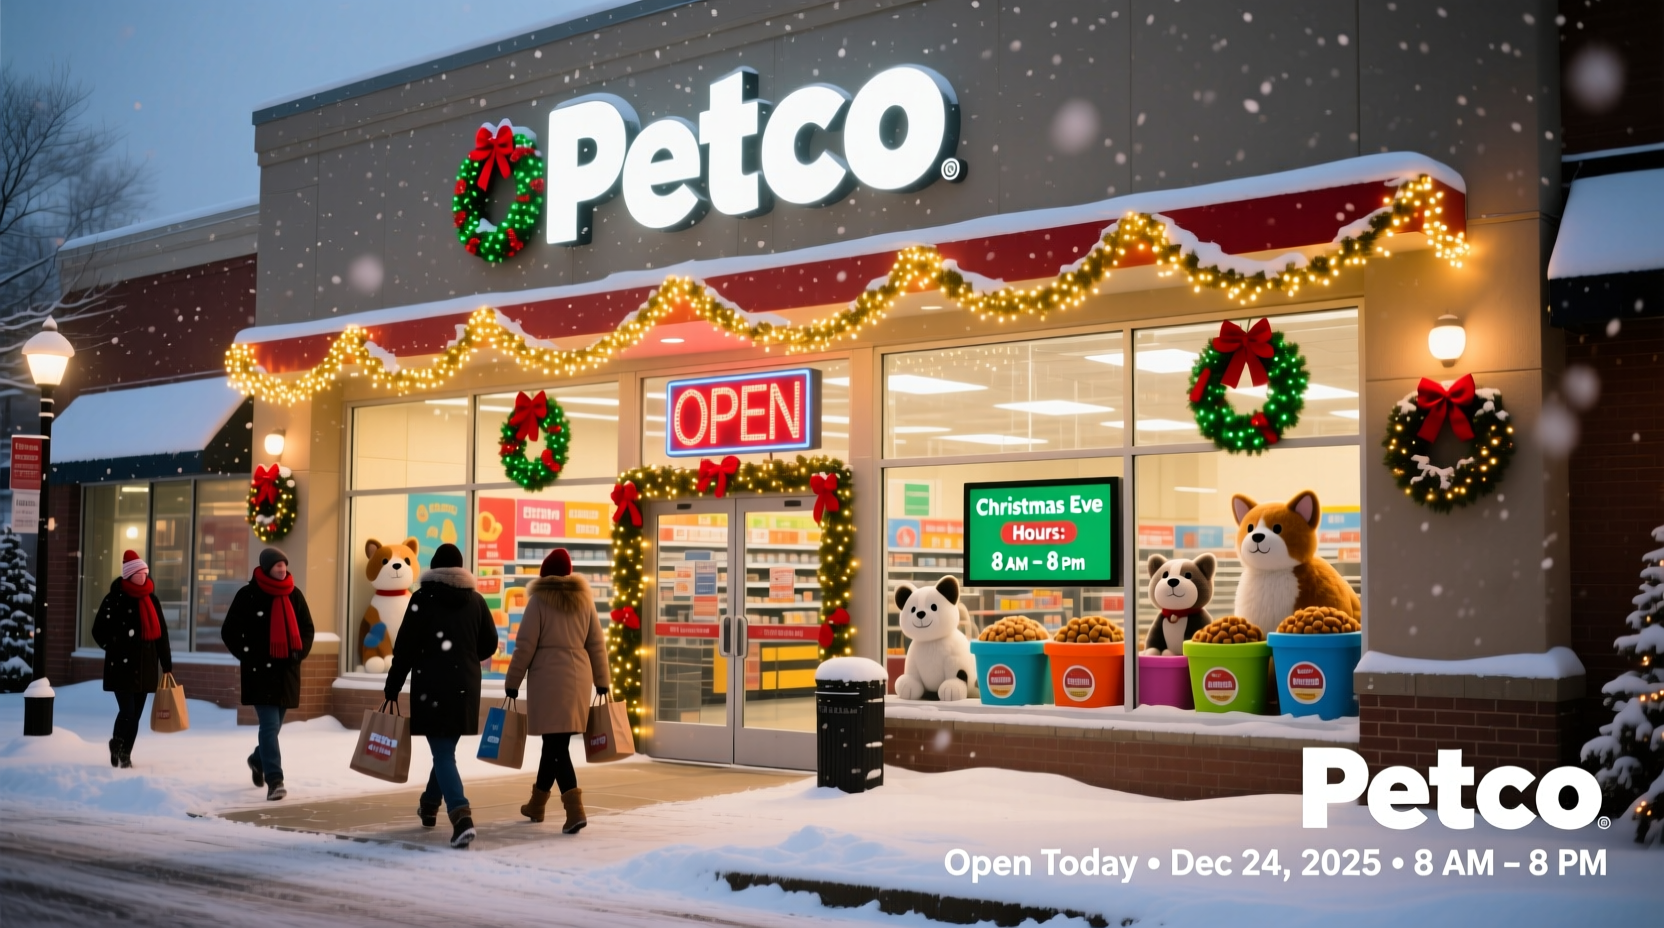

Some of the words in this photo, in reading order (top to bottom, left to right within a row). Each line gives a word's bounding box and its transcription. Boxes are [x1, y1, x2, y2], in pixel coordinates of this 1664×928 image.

[546, 65, 959, 244] Petco
[674, 381, 800, 446] OPEN
[976, 496, 1065, 516] Christmas
[1070, 495, 1103, 514] Eve
[1012, 525, 1065, 541] Hours:
[991, 551, 1003, 571] 8
[1005, 557, 1028, 571] AM
[1046, 551, 1059, 571] 8
